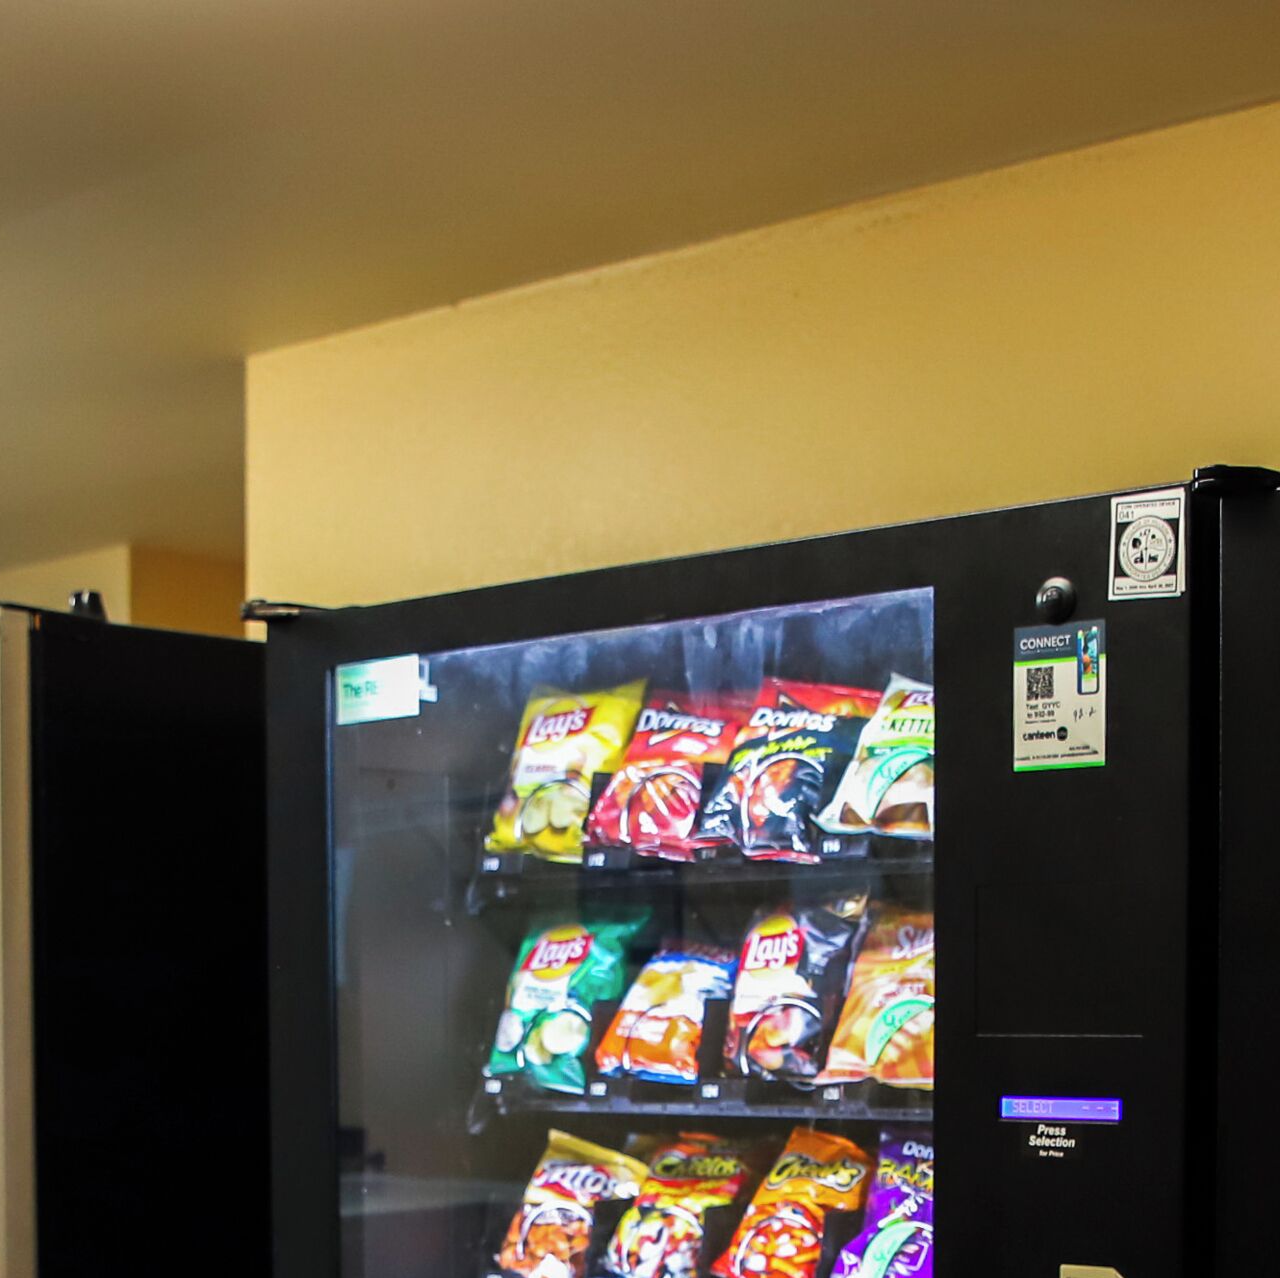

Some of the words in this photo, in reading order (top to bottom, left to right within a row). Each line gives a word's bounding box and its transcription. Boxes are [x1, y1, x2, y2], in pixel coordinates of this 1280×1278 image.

[1020, 634, 1070, 651] CONNECT
[528, 708, 587, 746] Lay's
[530, 933, 583, 970] Lay's
[746, 930, 798, 970] Lay's
[1012, 1102, 1054, 1114] SELECT
[1037, 1124, 1066, 1136] Press
[1029, 1135, 1075, 1148] Selection
